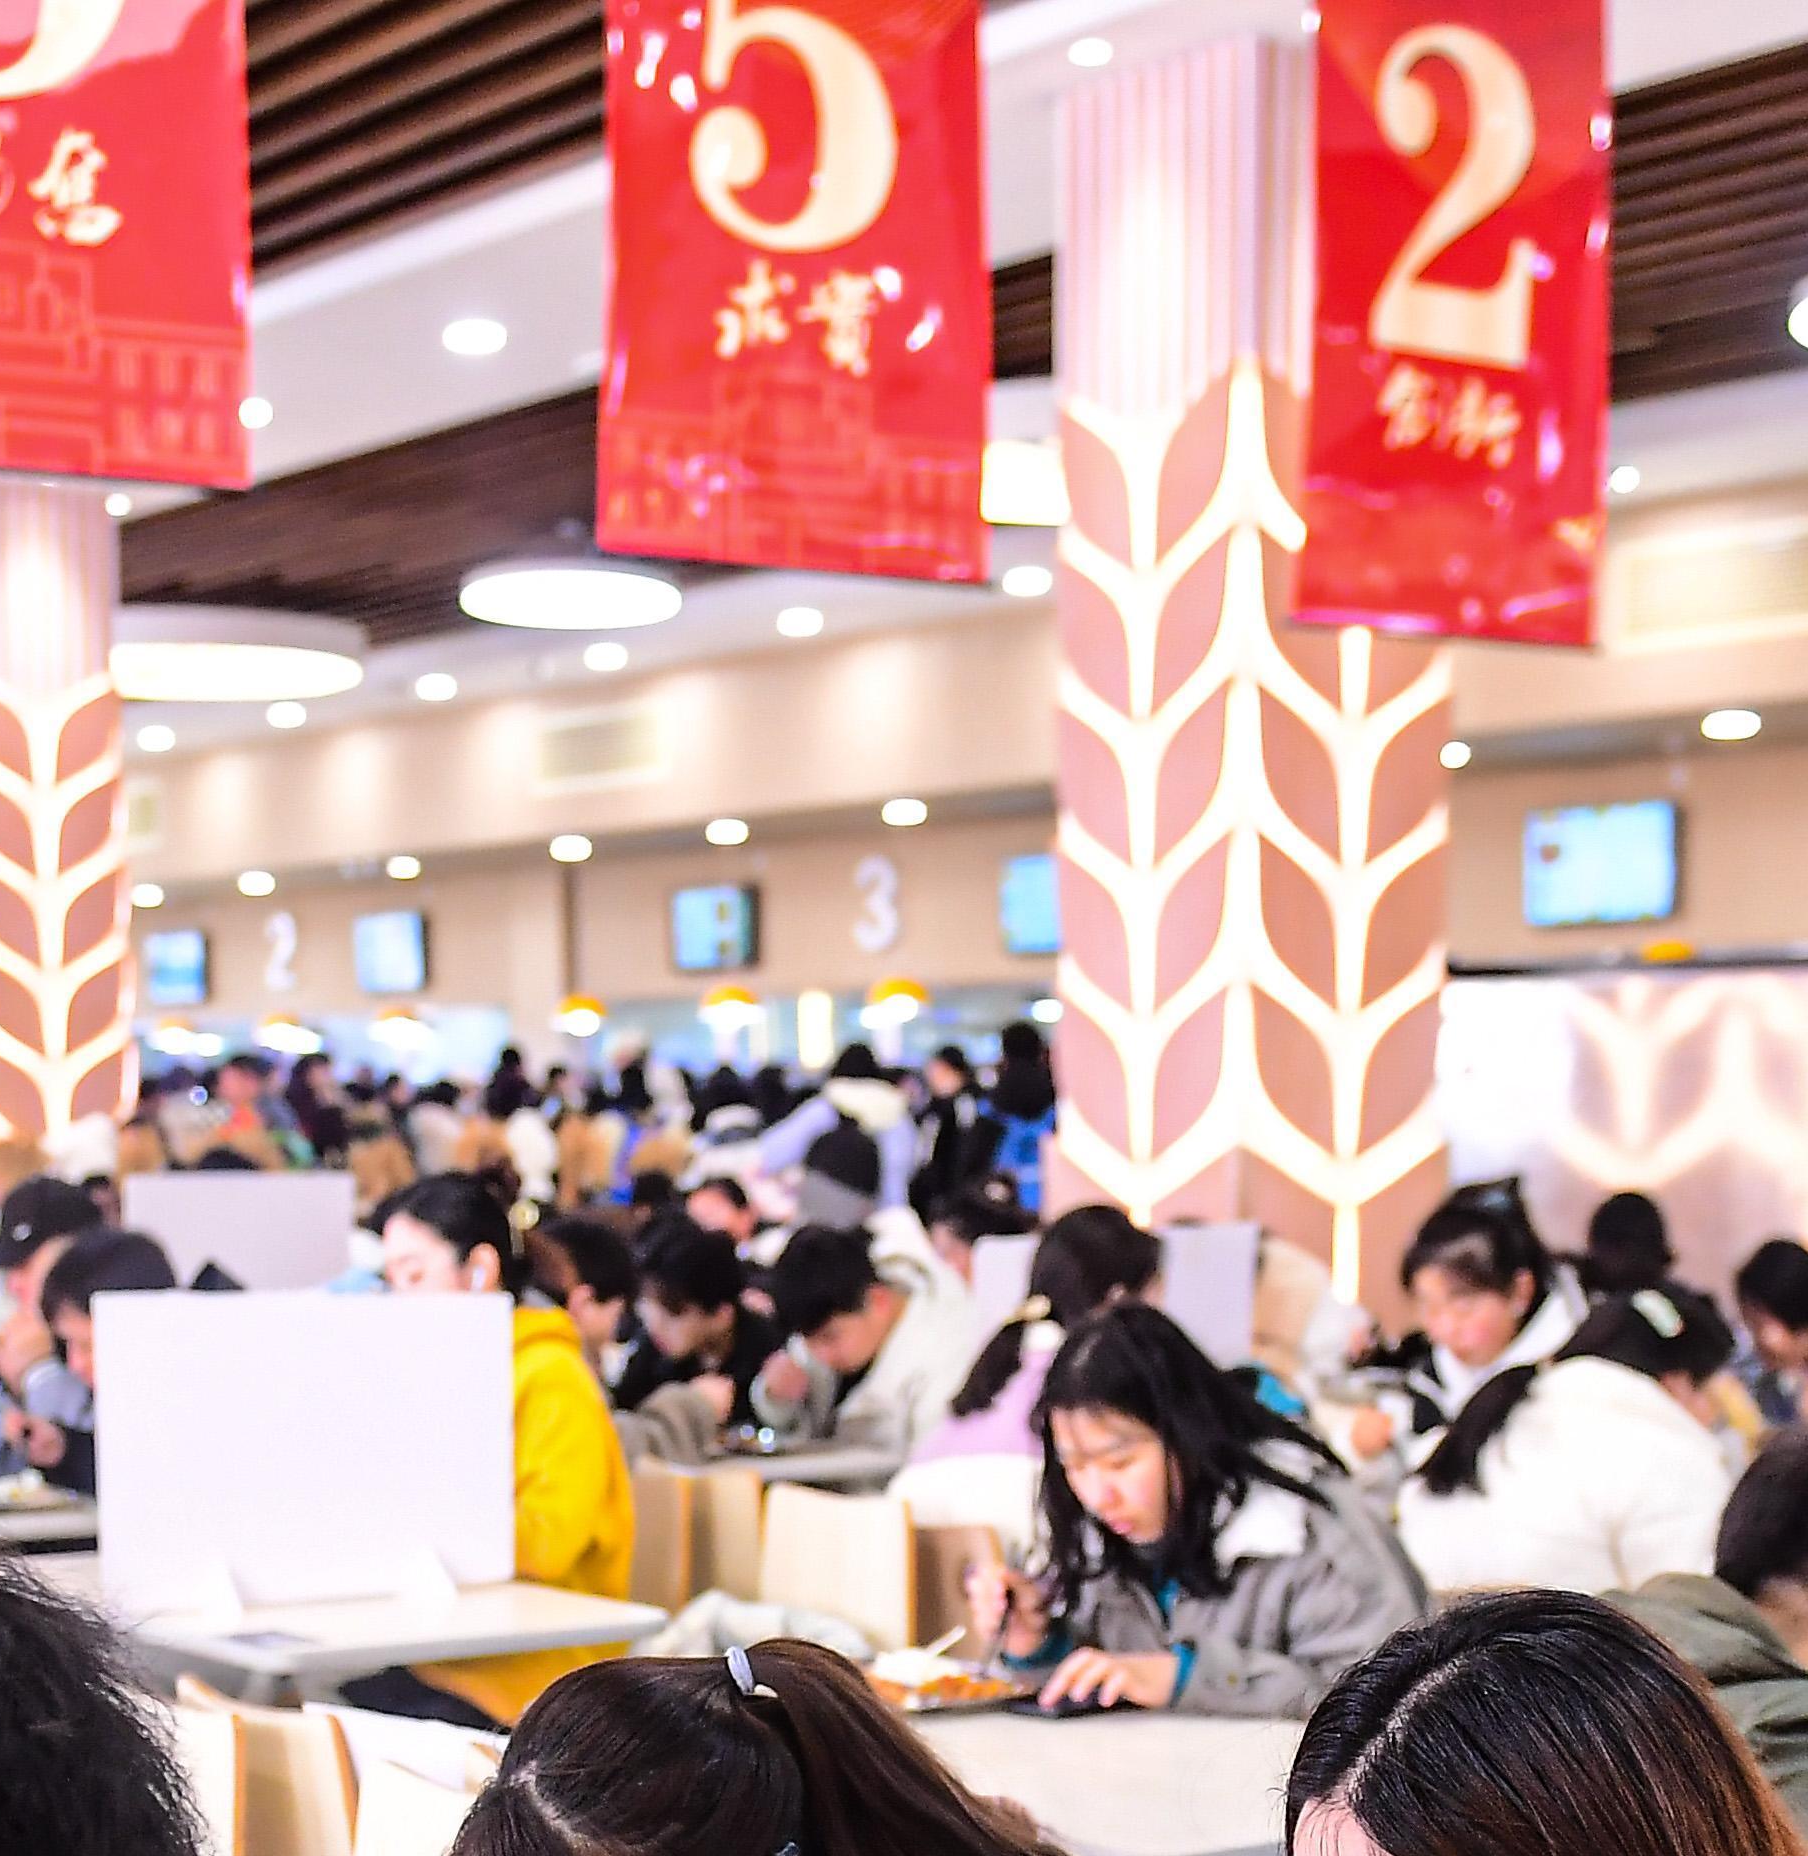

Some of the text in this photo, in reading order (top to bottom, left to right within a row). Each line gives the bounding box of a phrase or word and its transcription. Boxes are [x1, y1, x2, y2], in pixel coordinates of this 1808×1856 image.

[689, 0, 898, 253] 5
[1370, 23, 1536, 370] 2
[264, 910, 297, 992] 2
[853, 852, 899, 952] 3
